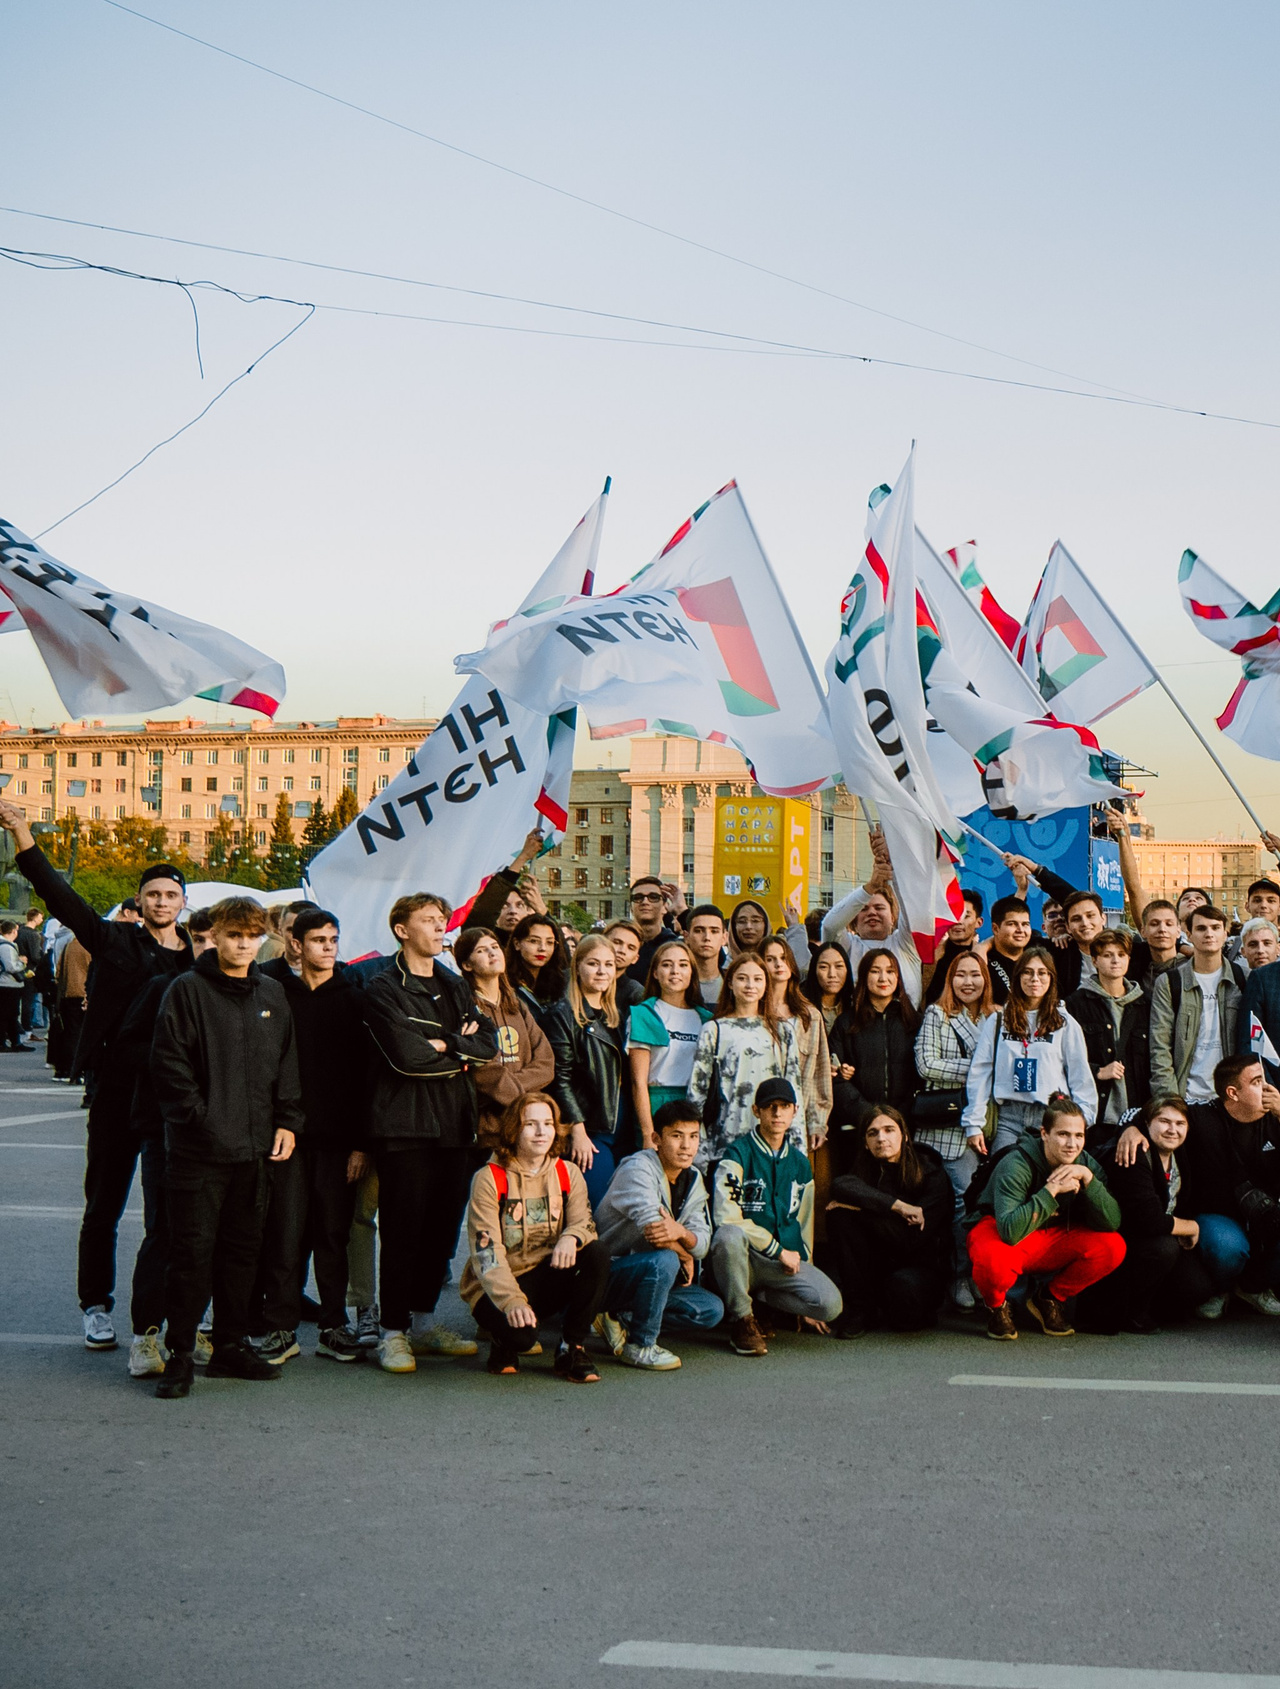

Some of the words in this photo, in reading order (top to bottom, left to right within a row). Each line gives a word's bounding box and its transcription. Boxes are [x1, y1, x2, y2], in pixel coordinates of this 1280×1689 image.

[726, 805, 774, 815] ПОЛУ
[725, 820, 774, 829] МАРА
[725, 834, 761, 843] ФОН
